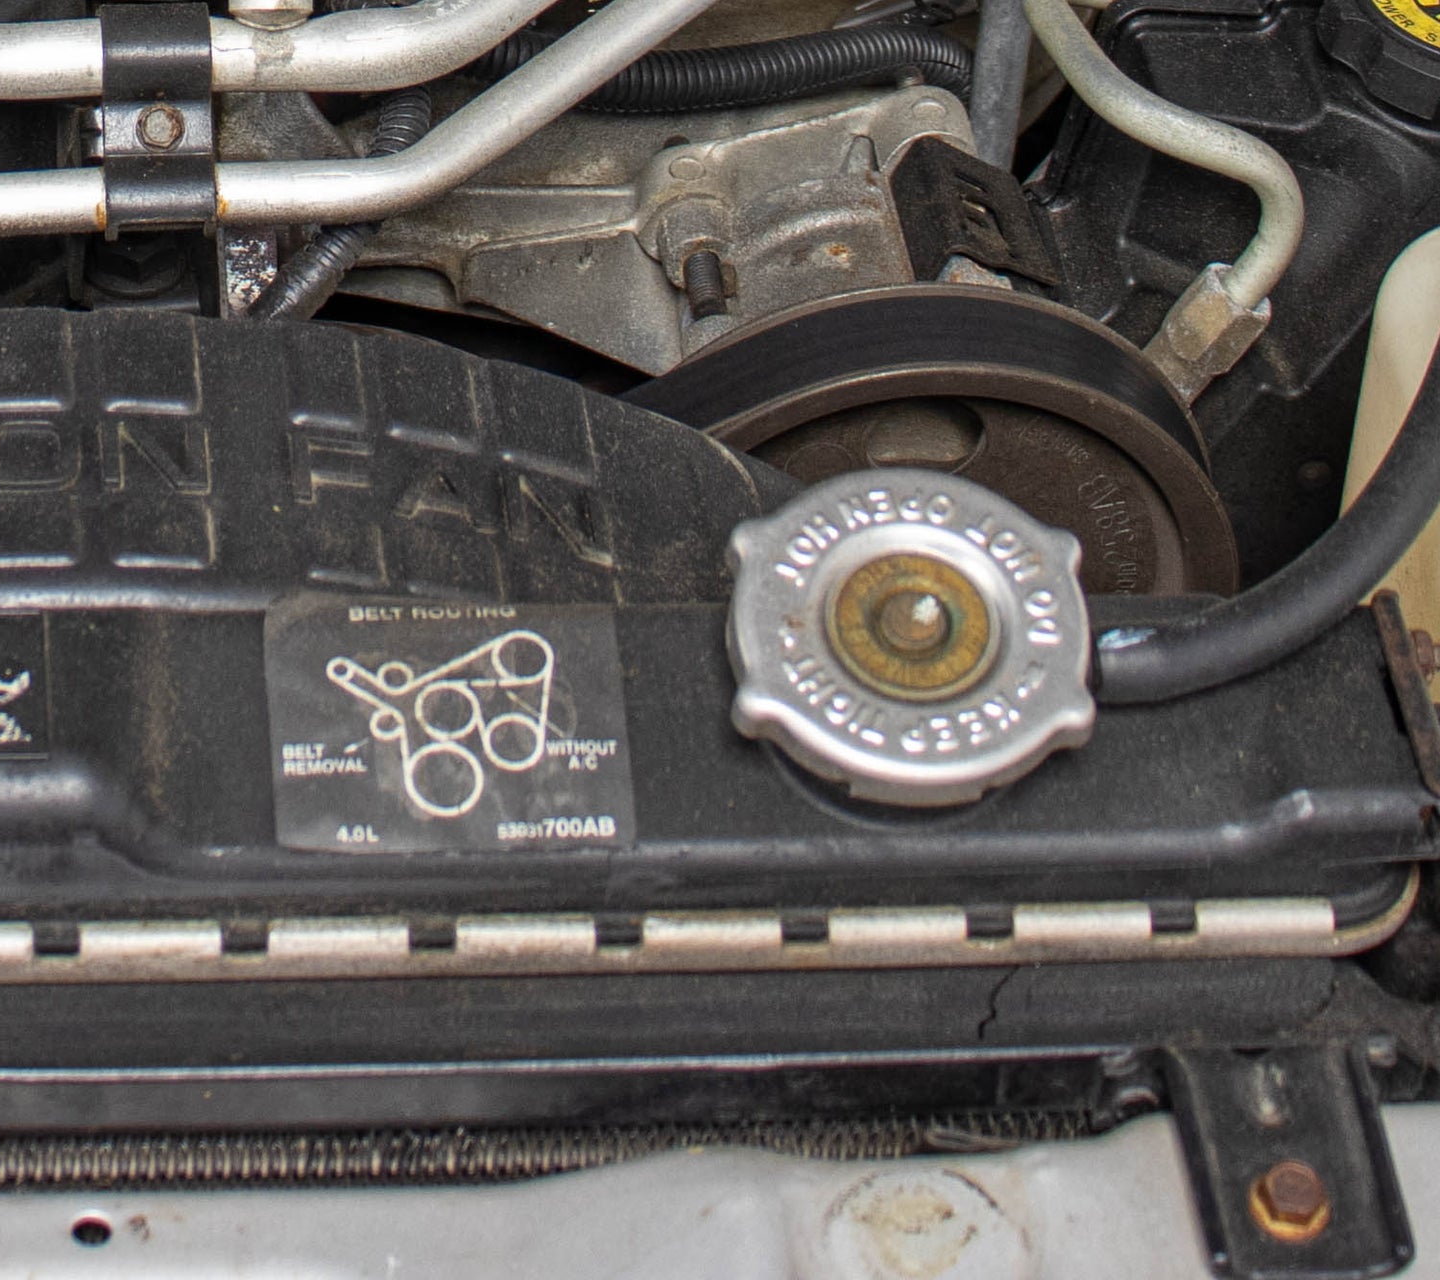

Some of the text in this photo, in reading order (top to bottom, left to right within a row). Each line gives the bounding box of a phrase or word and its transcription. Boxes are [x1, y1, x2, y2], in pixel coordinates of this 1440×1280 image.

[286, 426, 618, 568] FAN
[774, 489, 1063, 646] DO NOT OPEN HOT
[348, 604, 517, 622] BELT ROUTING
[780, 657, 1022, 754] KEEP TIGHT
[282, 744, 325, 761] BELT
[545, 739, 618, 757] WITHOUT
[283, 758, 369, 776] REMOVAL
[568, 755, 600, 772] A/C
